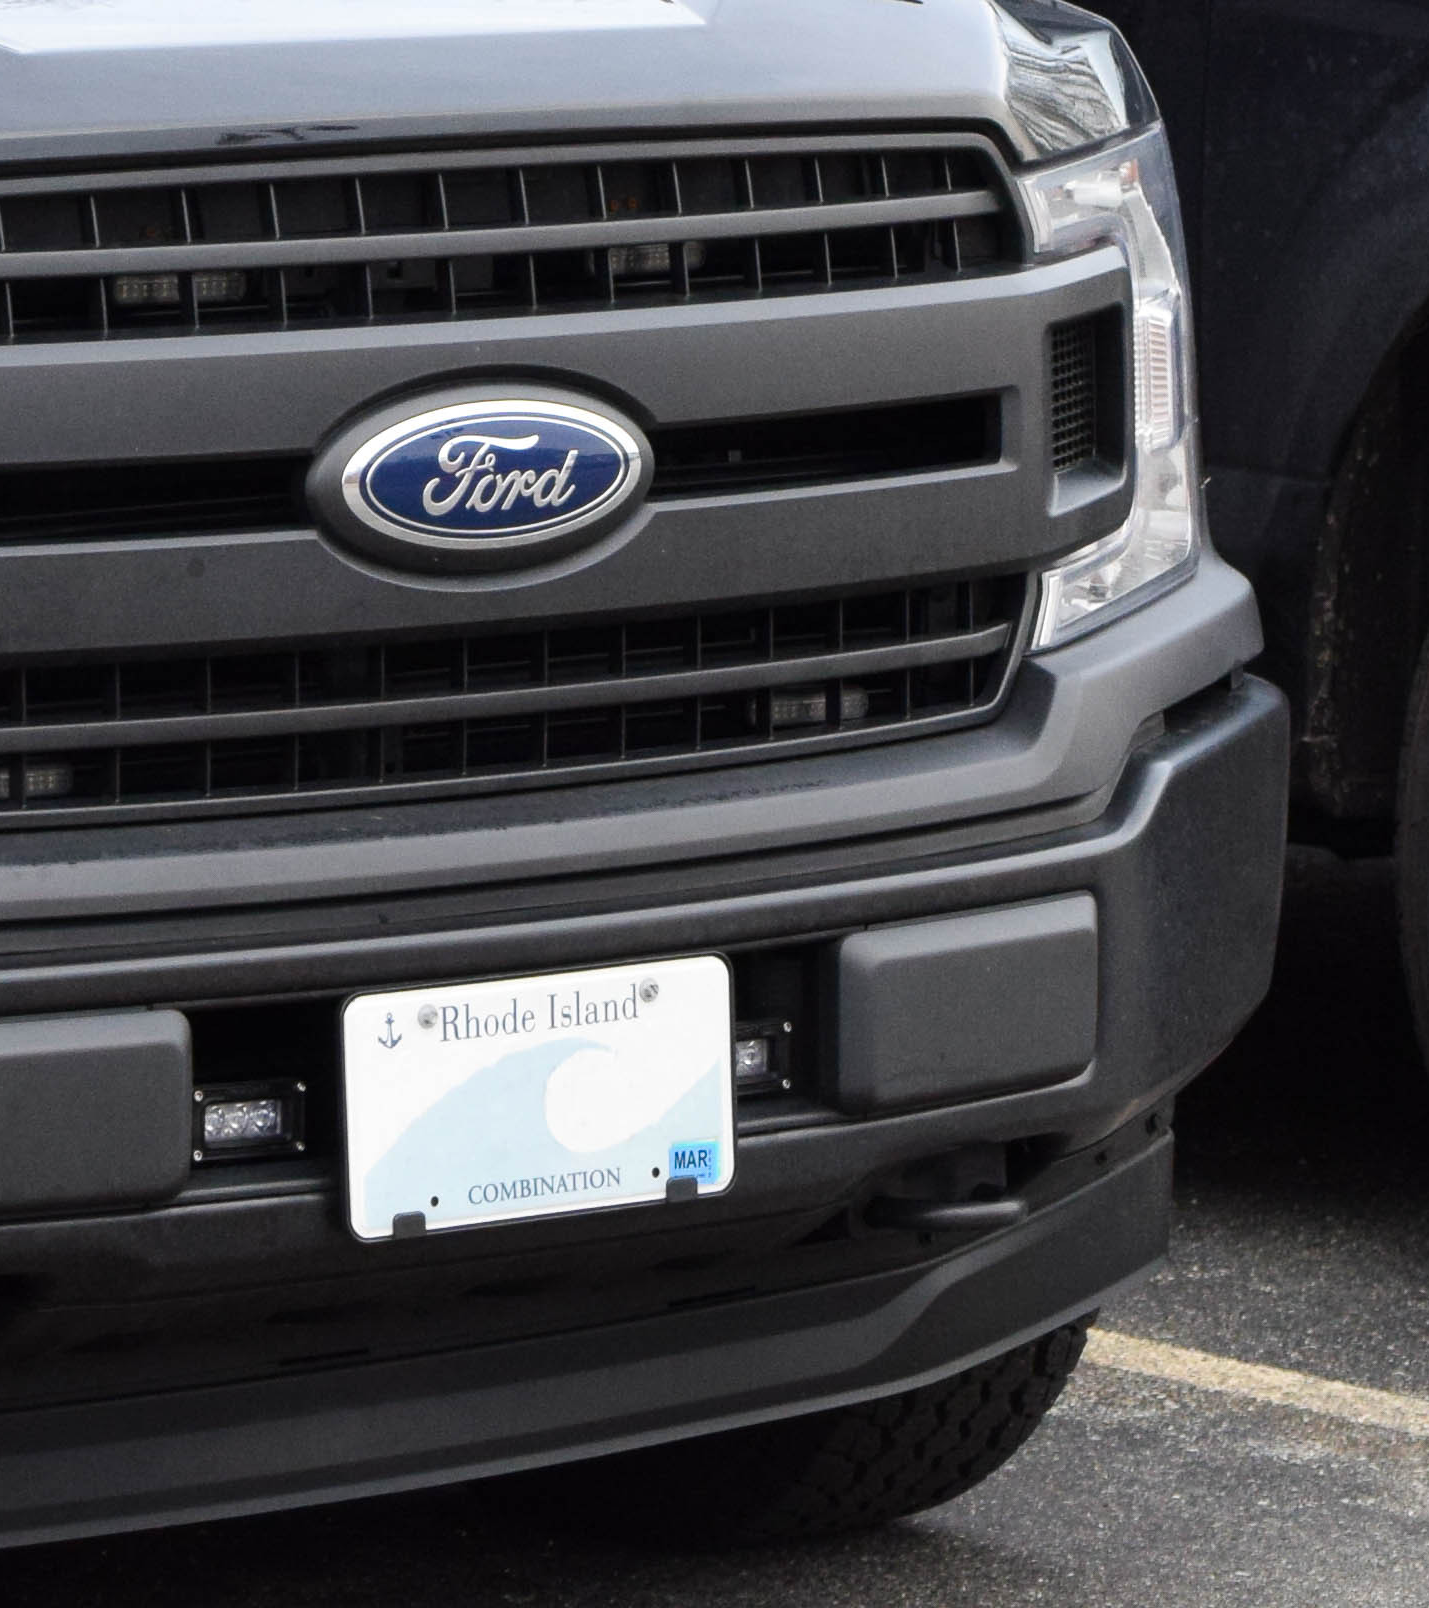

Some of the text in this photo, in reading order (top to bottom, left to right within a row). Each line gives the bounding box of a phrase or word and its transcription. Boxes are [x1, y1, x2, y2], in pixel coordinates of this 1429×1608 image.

[422, 433, 579, 516] Ford
[439, 983, 639, 1042] Rhode Island
[674, 1149, 708, 1169] MAR
[467, 1166, 622, 1206] COMBINATION
